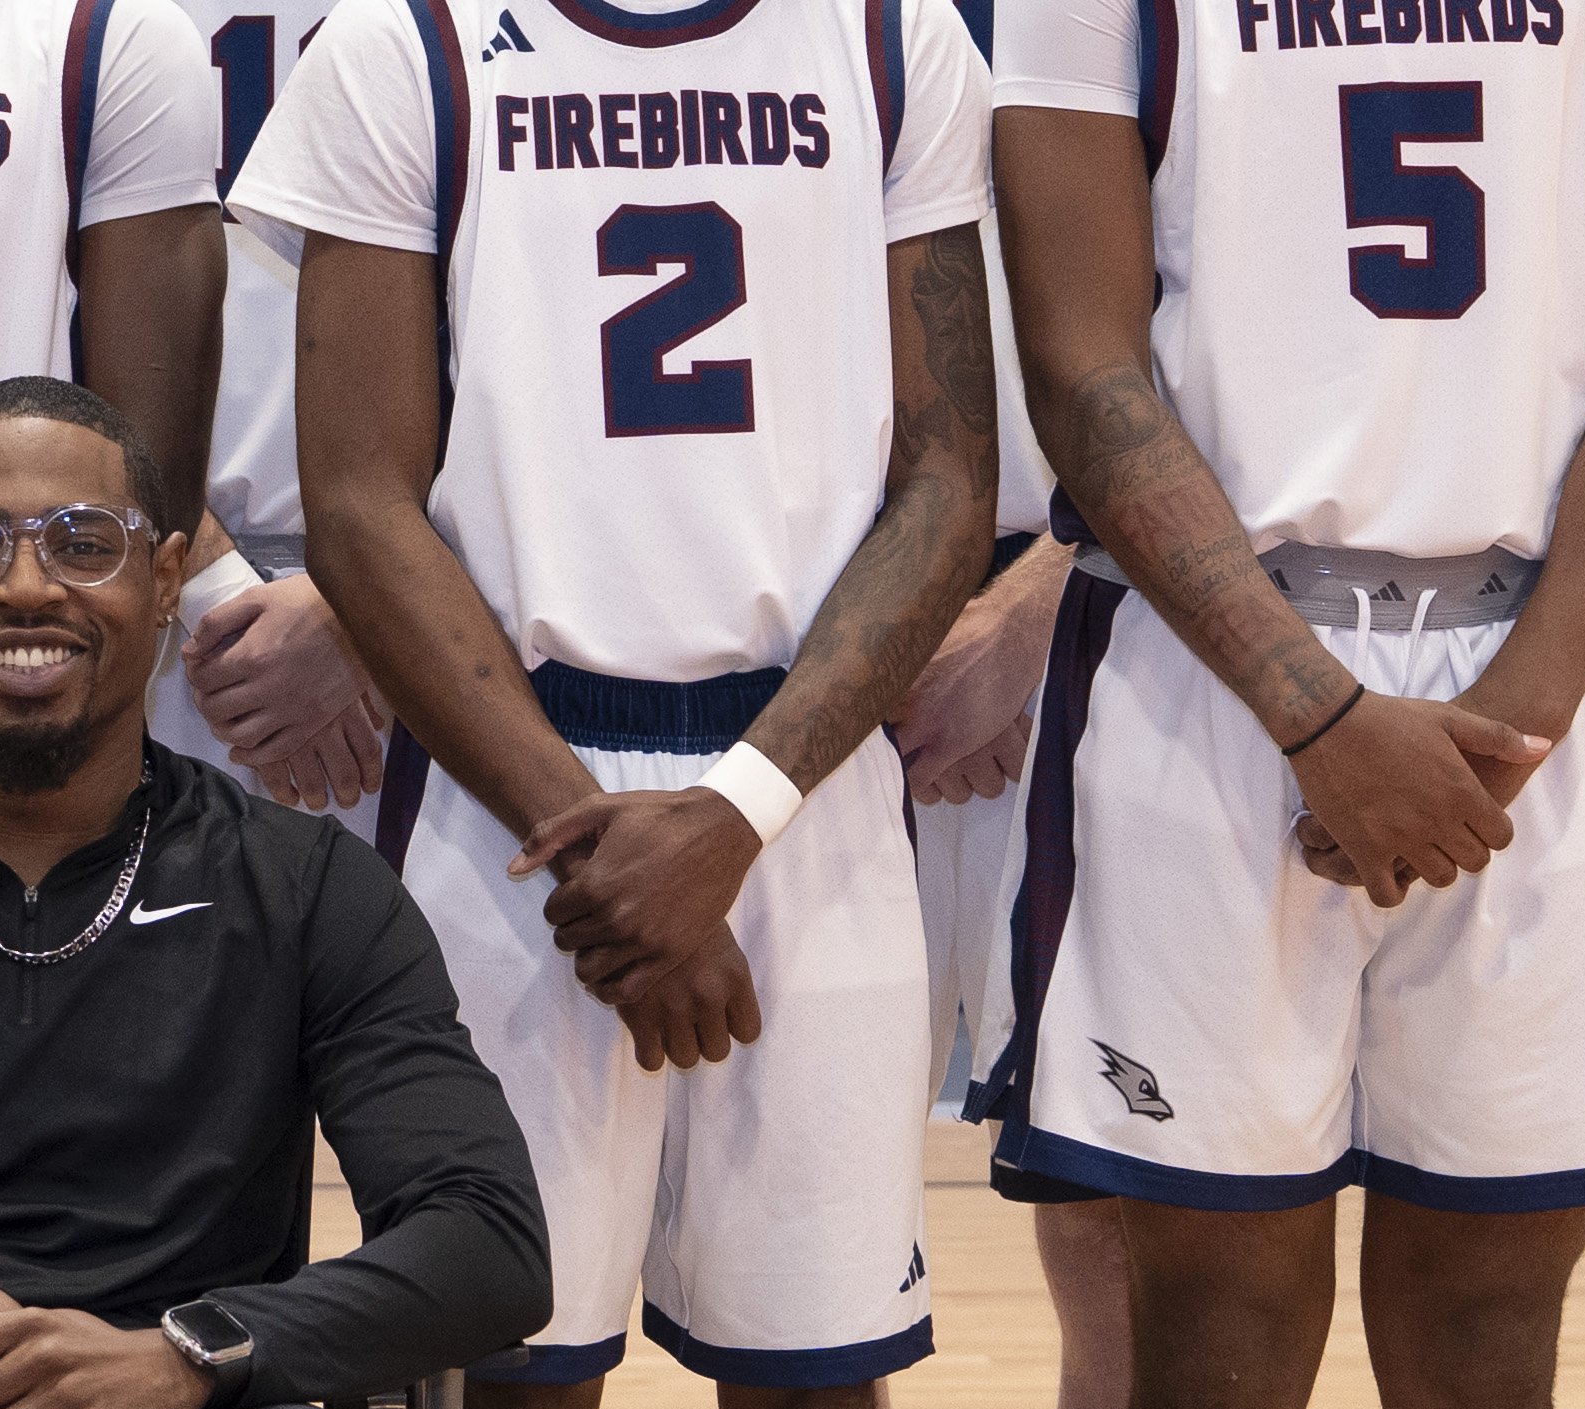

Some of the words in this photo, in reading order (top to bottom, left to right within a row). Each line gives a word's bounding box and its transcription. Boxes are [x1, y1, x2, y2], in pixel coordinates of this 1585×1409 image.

[211, 15, 328, 224] 1
[495, 89, 831, 172] FIREBIRDS
[1338, 80, 1487, 320] 5
[596, 200, 755, 438] 2
